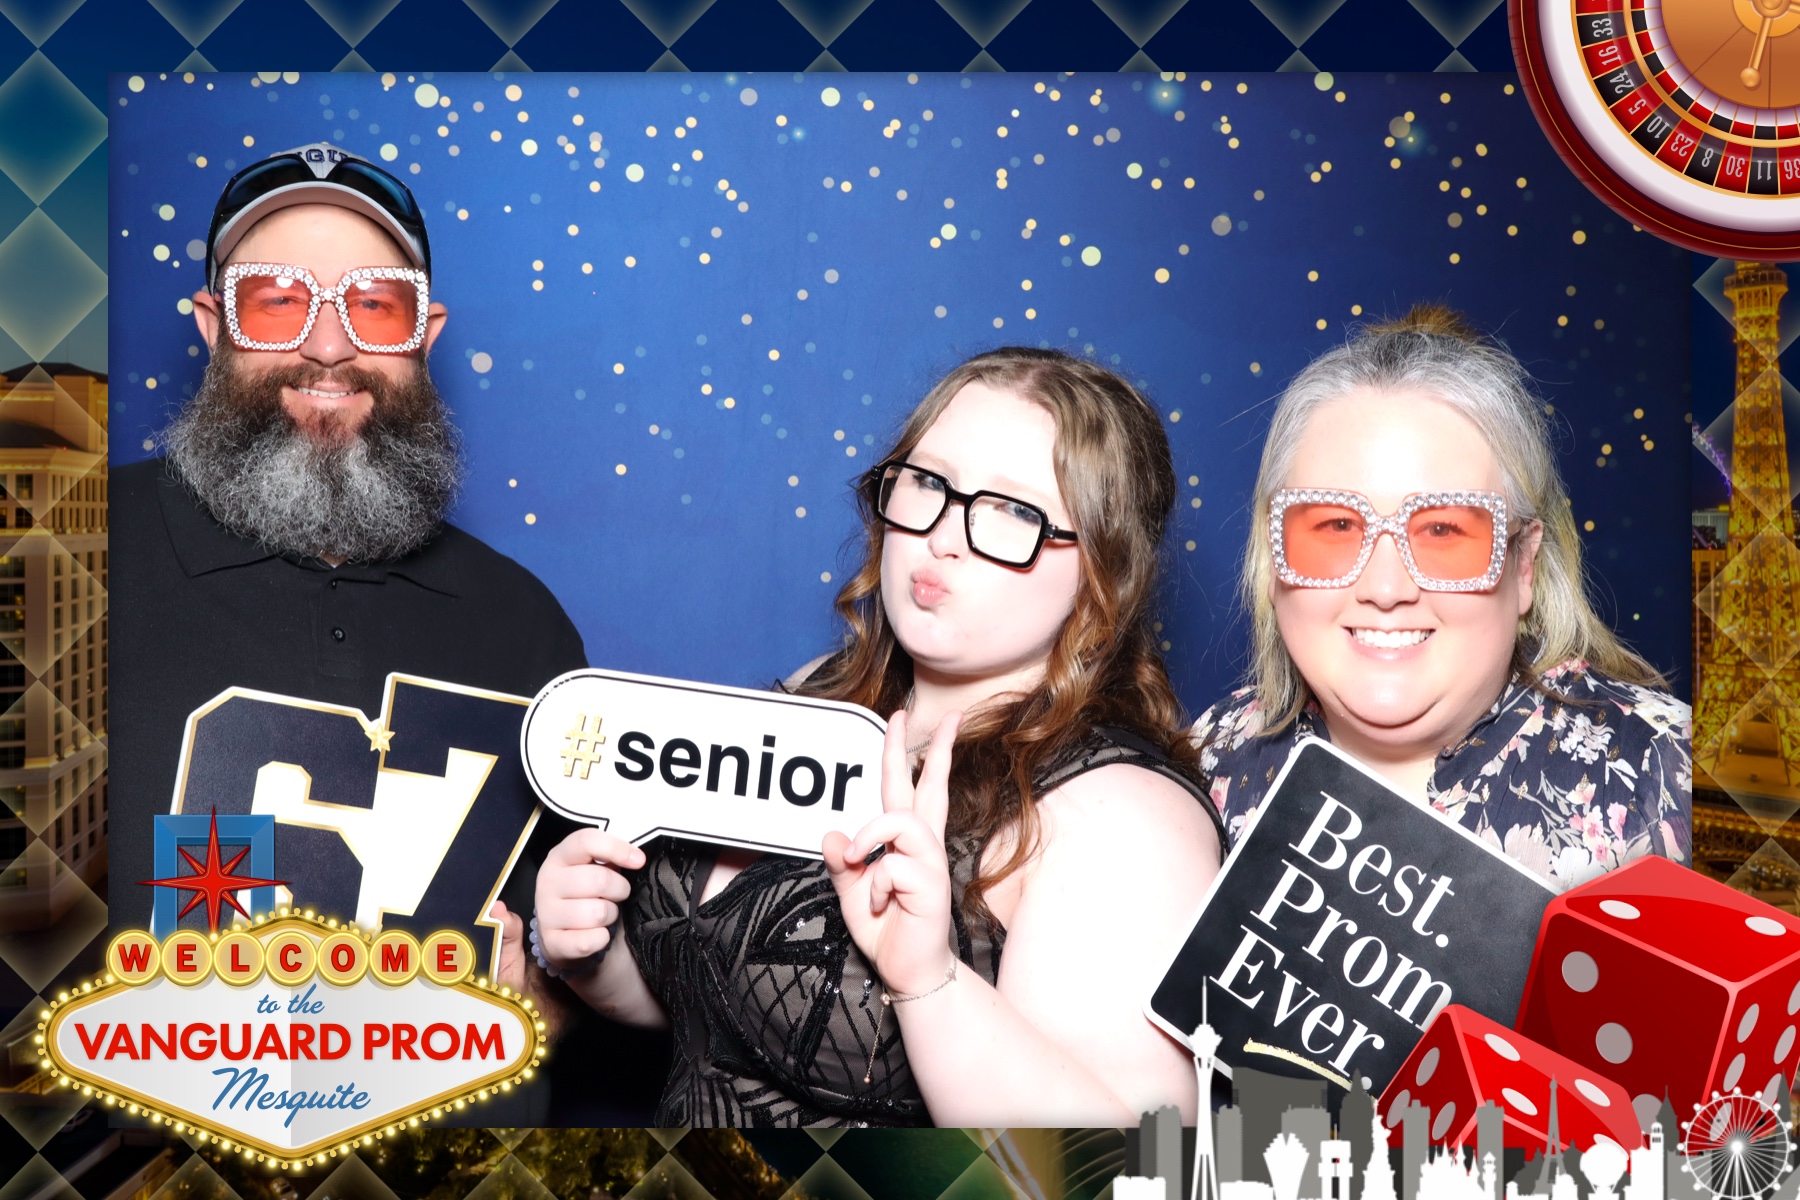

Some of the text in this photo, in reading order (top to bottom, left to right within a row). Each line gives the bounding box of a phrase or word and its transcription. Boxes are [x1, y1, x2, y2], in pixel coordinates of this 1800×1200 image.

[559, 713, 864, 812] #senior
[1250, 858, 1453, 1033] Prom
[1288, 790, 1456, 949] Best.
